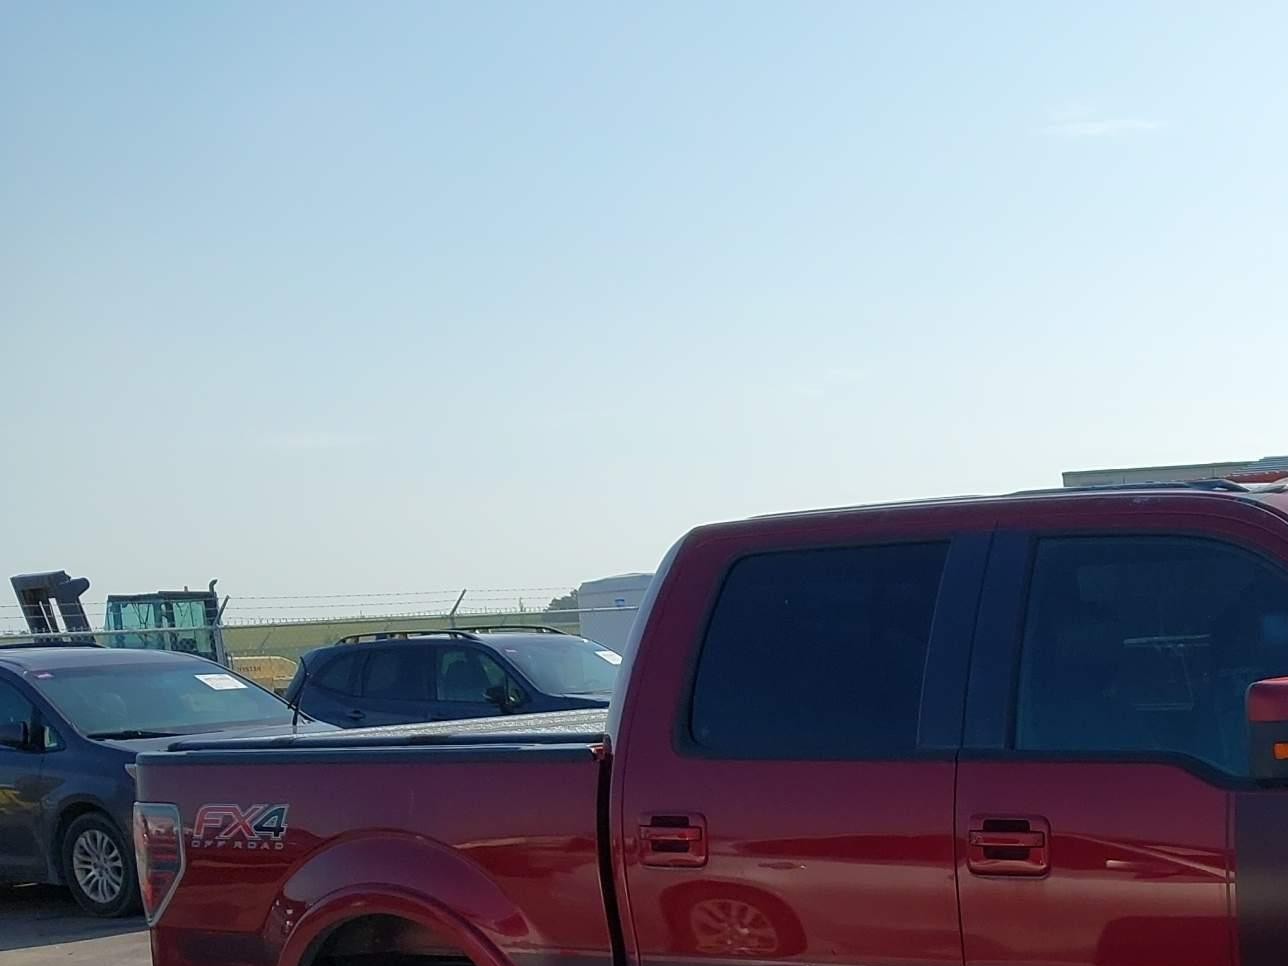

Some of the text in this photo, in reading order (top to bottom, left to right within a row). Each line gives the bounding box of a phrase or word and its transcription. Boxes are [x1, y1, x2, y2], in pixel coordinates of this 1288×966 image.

[193, 804, 290, 840] FX4
[191, 840, 284, 850] OFF ROAD
